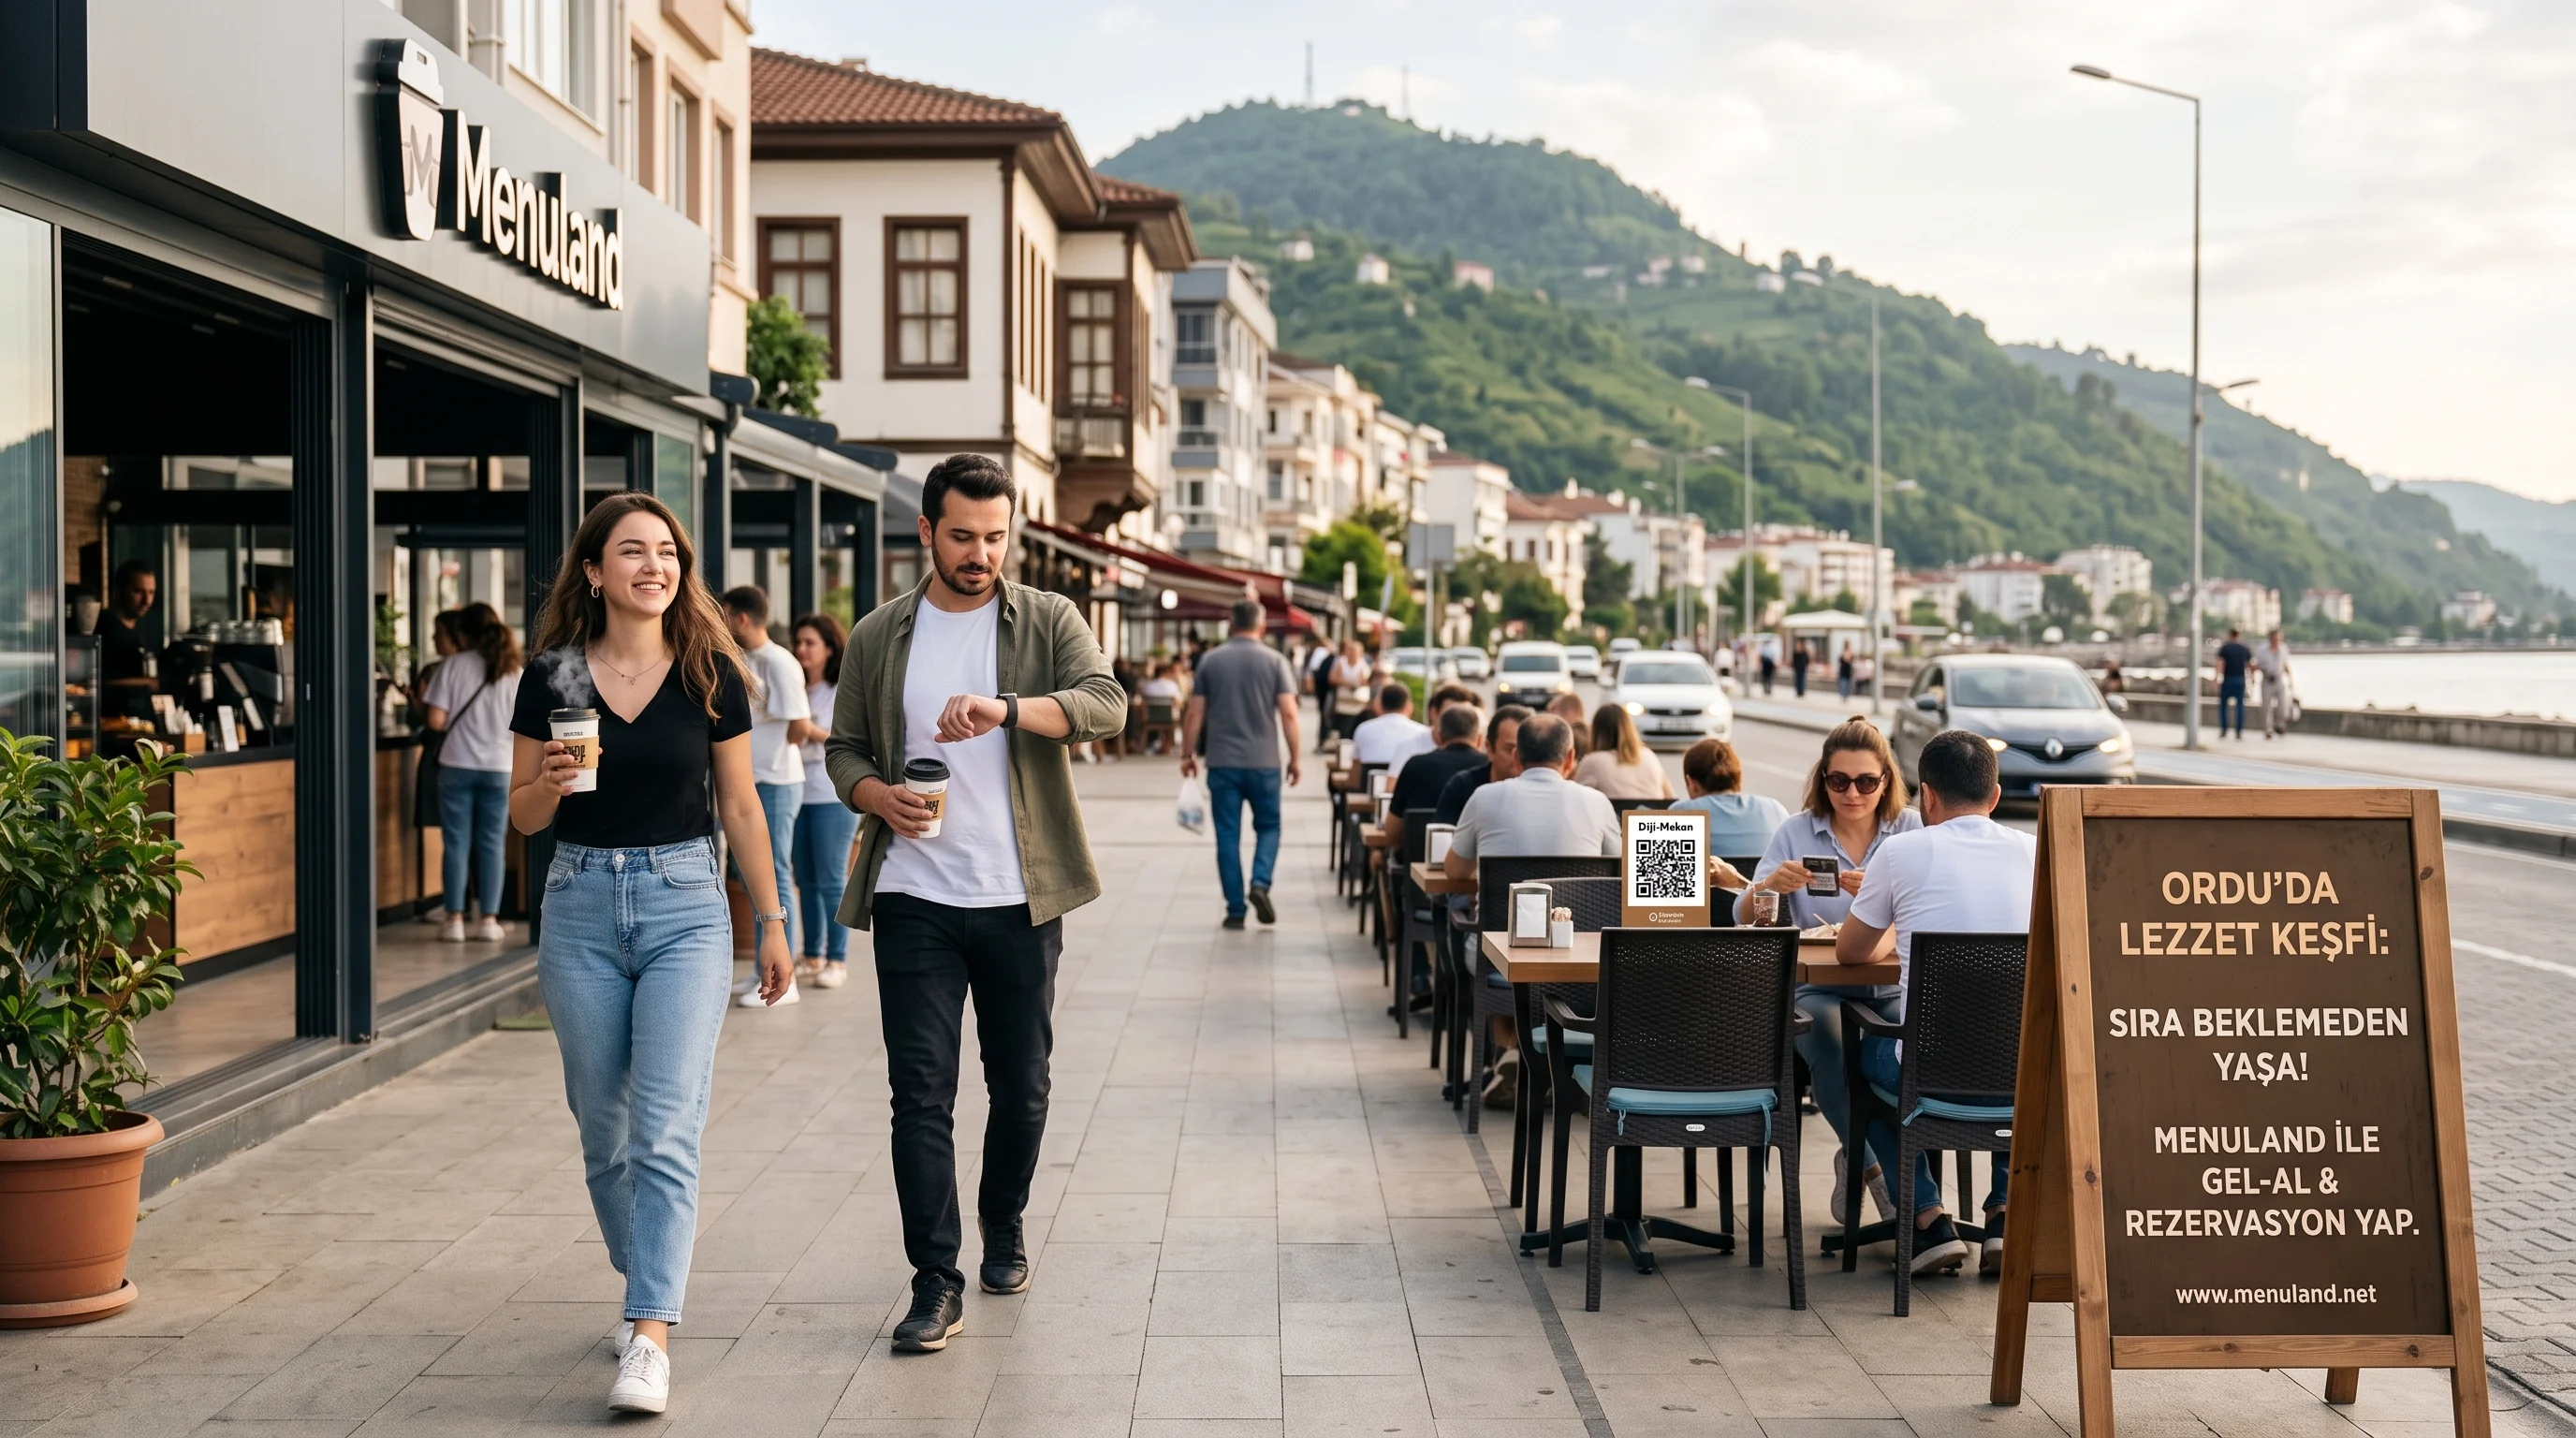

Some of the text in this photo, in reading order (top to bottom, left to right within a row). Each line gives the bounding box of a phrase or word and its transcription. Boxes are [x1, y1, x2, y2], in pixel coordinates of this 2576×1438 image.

[457, 109, 624, 311] Menuland
[1638, 822, 1693, 833] Diji-Mekan
[2161, 871, 2339, 905] ORDU’DA
[2119, 913, 2389, 963] LEZZET KEŞFİ:
[2109, 1007, 2408, 1038] SIRA BEKLEMEDEN
[2212, 1051, 2308, 1087] YAŞA!
[2154, 1119, 2380, 1154] MENULAND İLE
[2202, 1167, 2339, 1196] GEL-AL &
[2125, 1208, 2420, 1237] REZERVASYON YAP.
[2175, 1284, 2378, 1304] www.menuland.net
